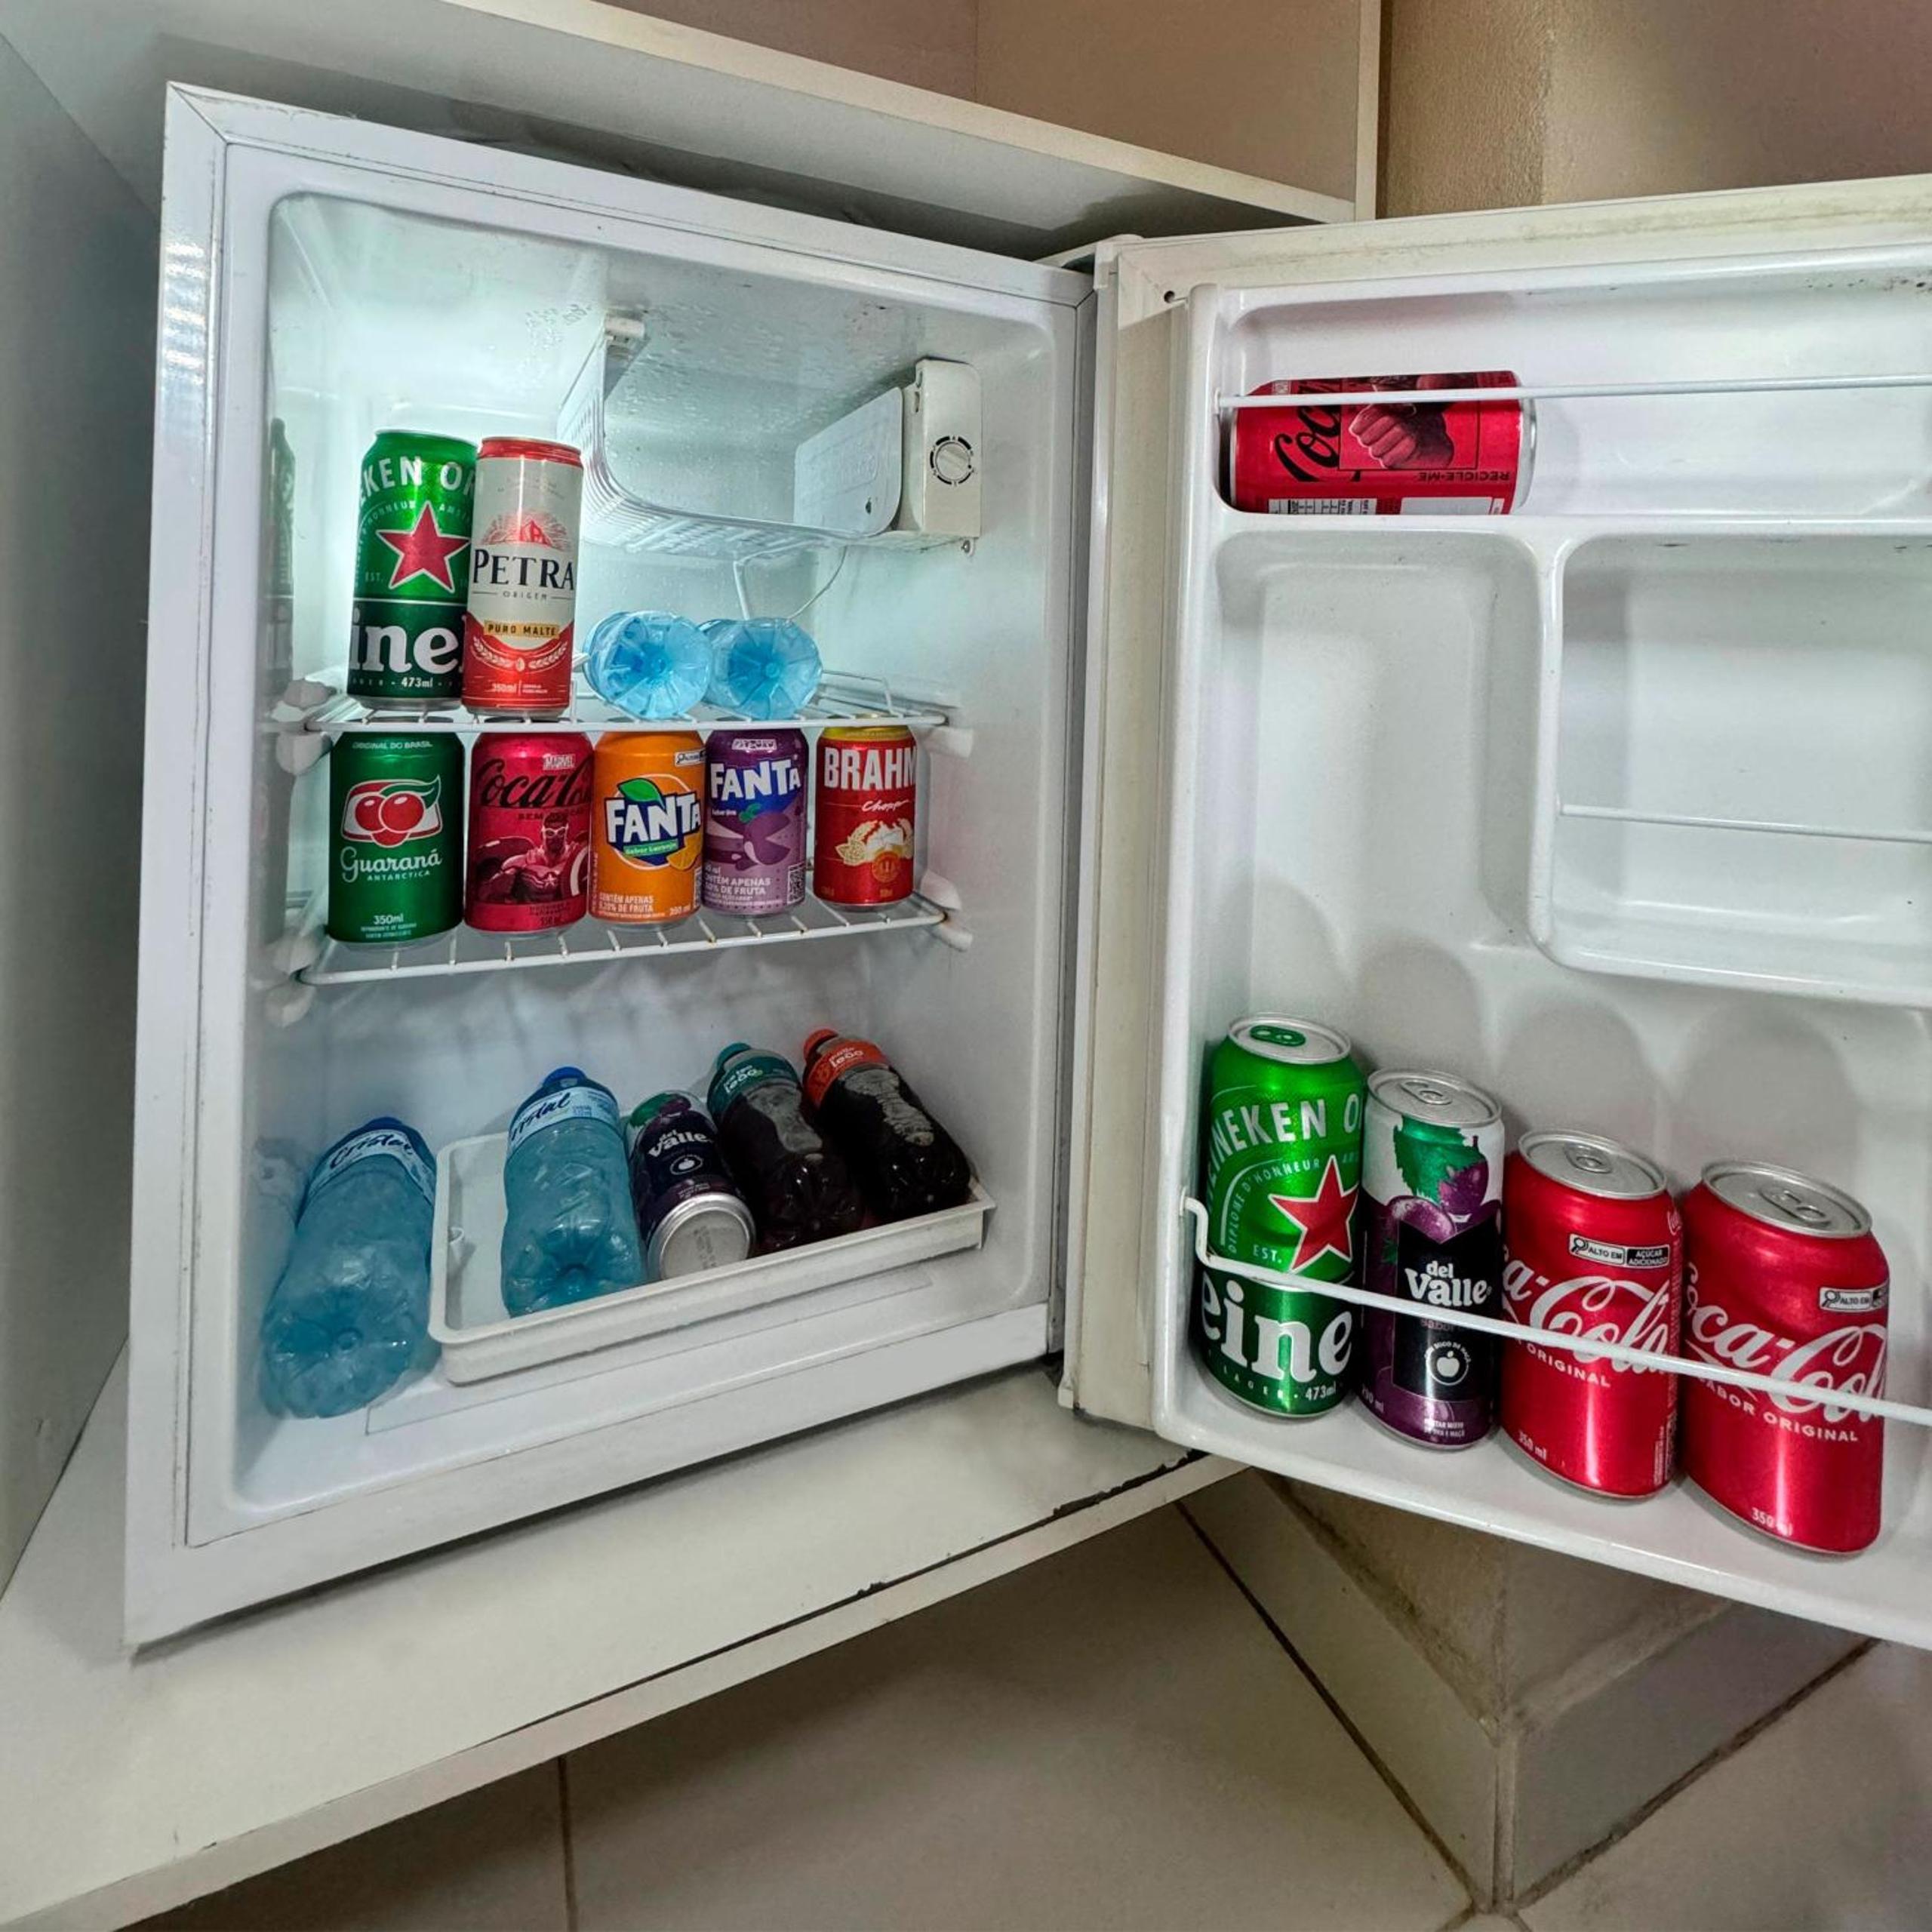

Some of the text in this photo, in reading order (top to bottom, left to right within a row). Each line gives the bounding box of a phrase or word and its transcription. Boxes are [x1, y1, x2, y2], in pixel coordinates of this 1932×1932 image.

[360, 456, 423, 508] KEN
[473, 549, 574, 591] PETRA
[349, 608, 466, 674] ine
[488, 624, 557, 637] PURO MALTE
[401, 677, 433, 688] 473ml
[710, 759, 801, 801] FANTA
[606, 793, 701, 843] FANTA
[340, 846, 443, 883] Guaraná
[367, 870, 430, 881] ANTARCTICA
[731, 878, 771, 887] APENAS
[721, 885, 734, 894] DE
[734, 887, 766, 895] FRUTA
[374, 913, 404, 925] 350ml
[648, 1131, 711, 1157] Valle
[1253, 1245, 1282, 1263] EST.
[1587, 1246, 1610, 1258] ALTO
[1635, 1247, 1663, 1260] AÇÚCAR
[1426, 1260, 1454, 1279] del
[1404, 1267, 1487, 1306] Valle
[1841, 1297, 1859, 1305] ALTO
[1527, 1343, 1611, 1388] ORIGINAL
[1305, 1381, 1337, 1401] 473ml
[1700, 1378, 1755, 1416] ABOR
[1763, 1411, 1859, 1441] ORIGINAL
[1751, 1506, 1774, 1529] 350
